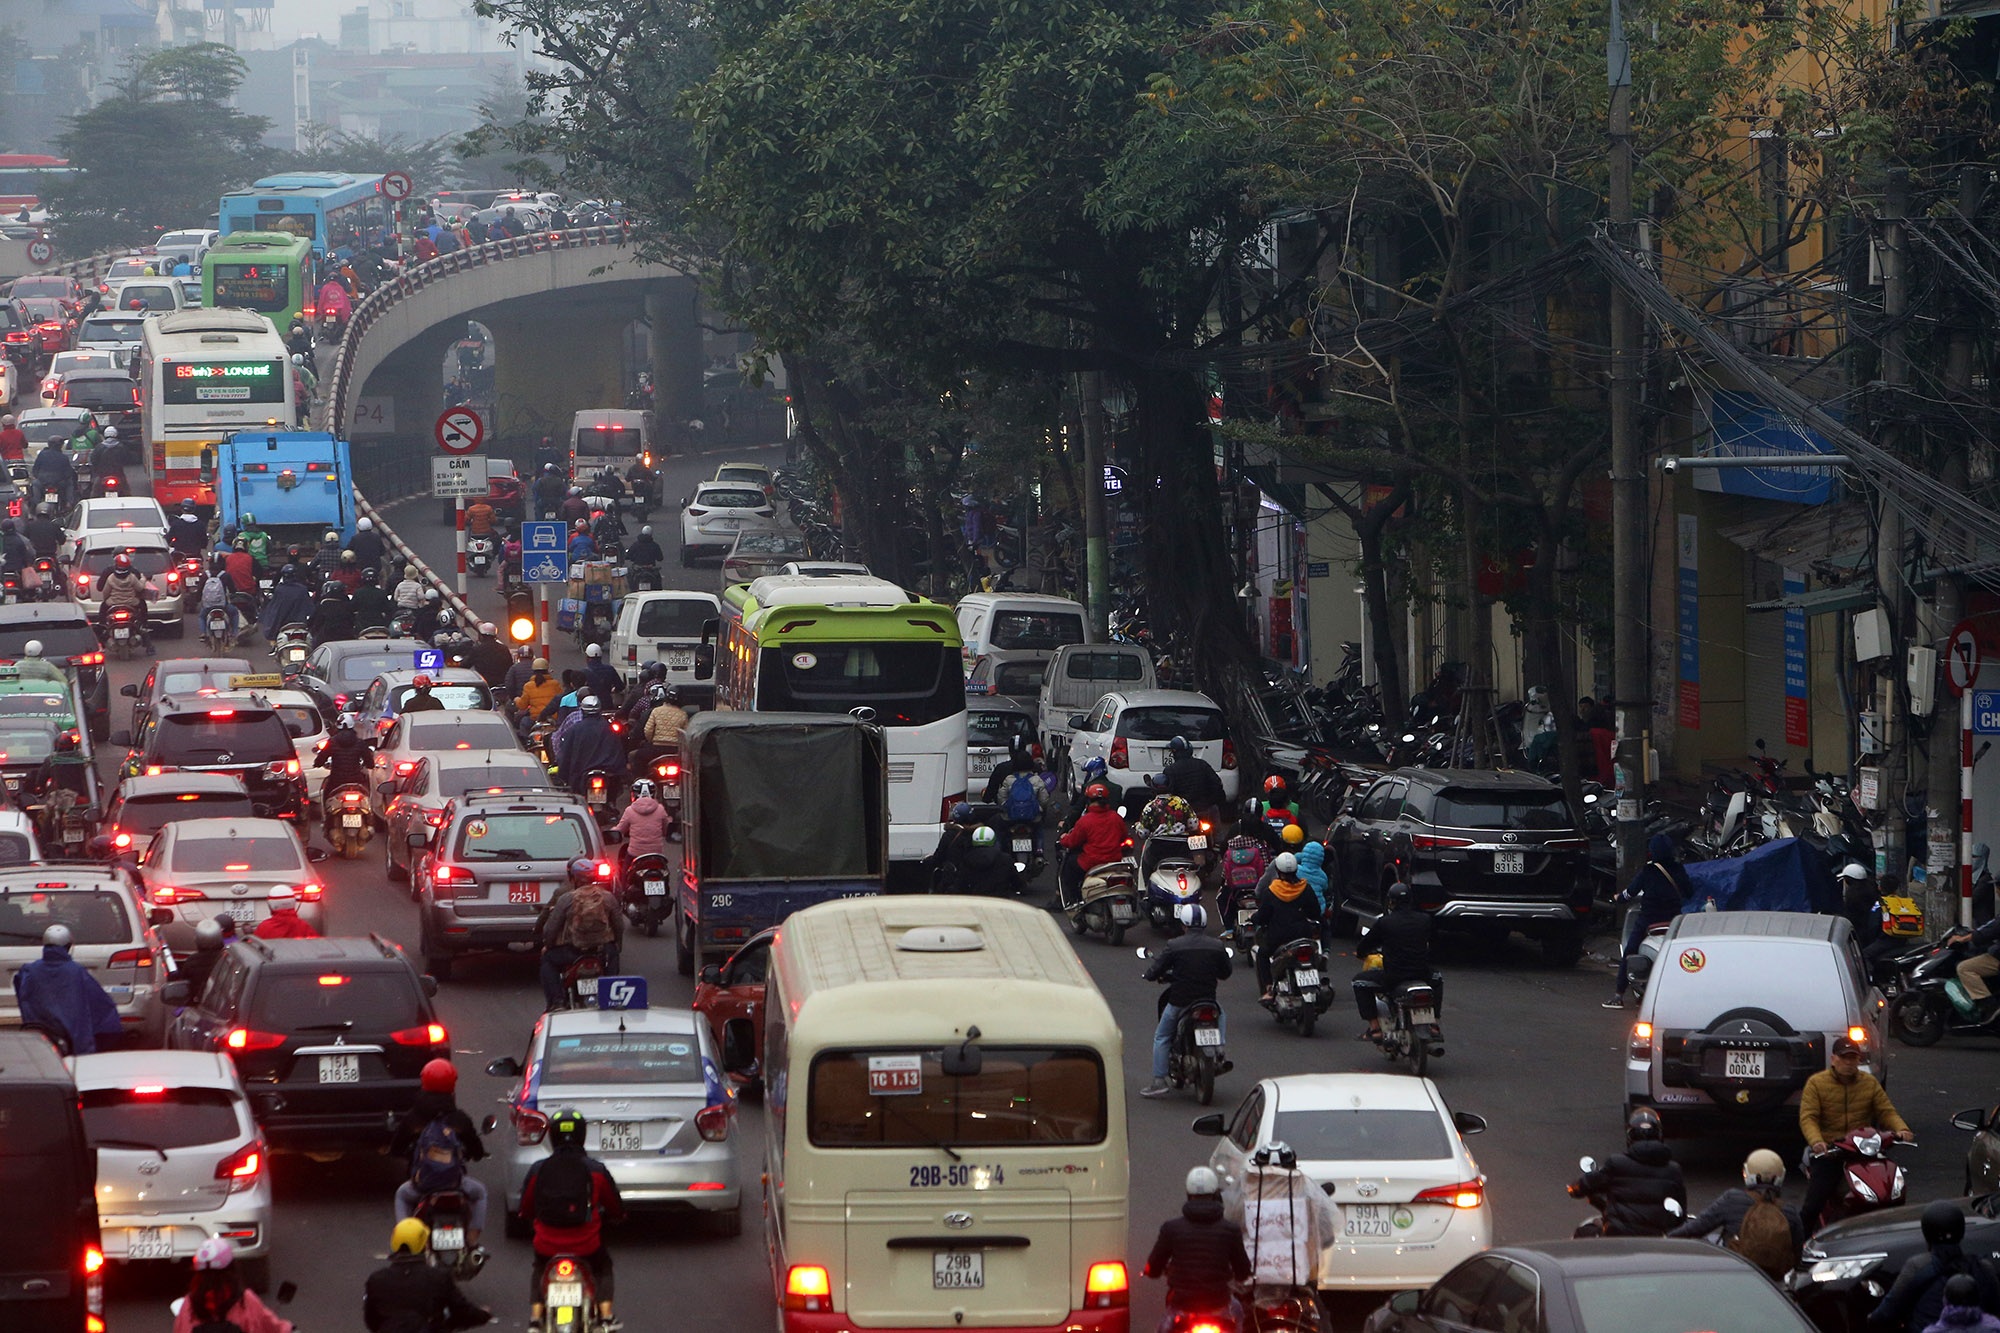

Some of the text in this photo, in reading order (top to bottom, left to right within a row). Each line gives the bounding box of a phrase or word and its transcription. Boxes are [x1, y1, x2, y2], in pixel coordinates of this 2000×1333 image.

[176, 365, 193, 377] 65
[224, 366, 253, 376] LONG
[354, 404, 384, 424] P4
[449, 458, 470, 469] CẤM
[1103, 479, 1122, 490] TEL
[420, 651, 437, 667] G7
[1501, 853, 1517, 862] 30E
[1495, 863, 1523, 872] 931.63
[510, 892, 536, 903] 22-51
[711, 894, 733, 908] 29C
[609, 980, 636, 1006] G7
[1729, 1064, 1760, 1075] 000.46
[871, 1071, 918, 1087] TC 1.13
[610, 1123, 632, 1136] 30E
[601, 1137, 640, 1150] 641.98
[910, 1164, 1004, 1187] 29B-504
[1356, 1206, 1379, 1219] 99A
[1347, 1220, 1389, 1234] 312.70
[946, 1255, 971, 1269] 29B
[935, 1271, 981, 1286] 503.44
